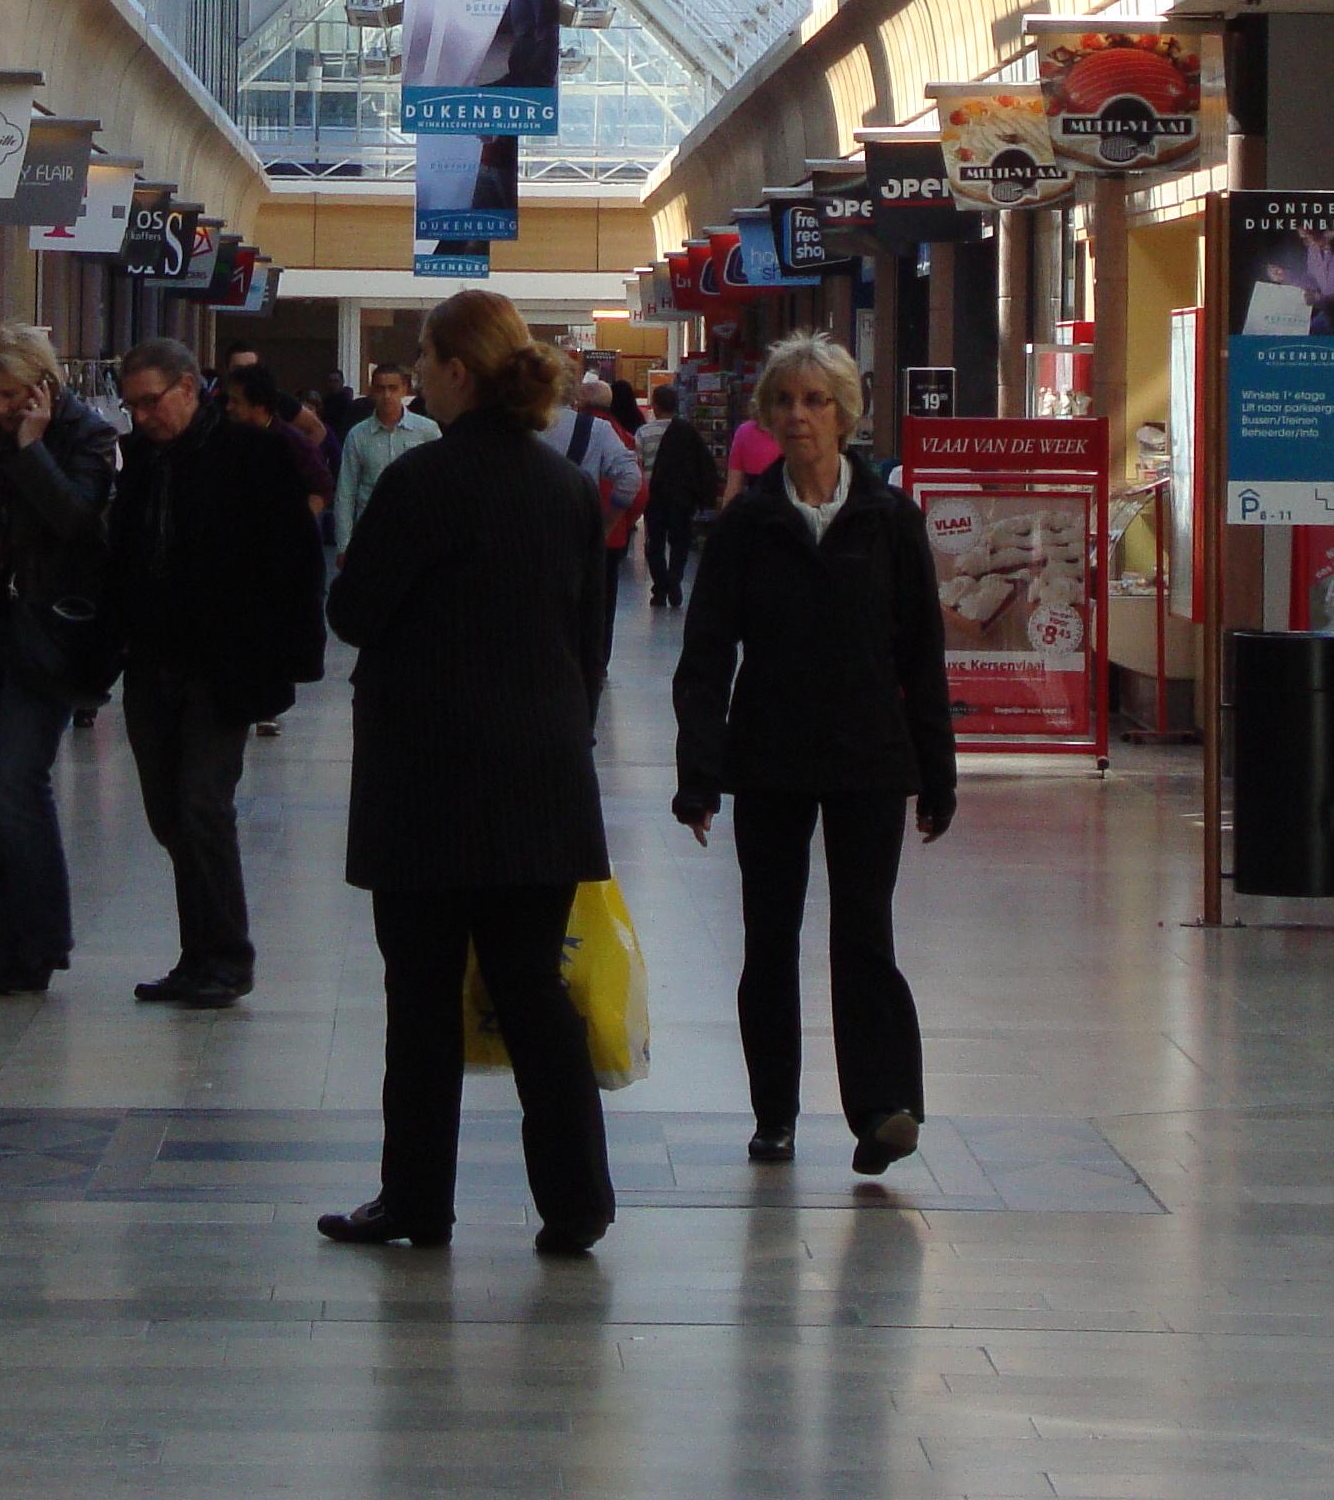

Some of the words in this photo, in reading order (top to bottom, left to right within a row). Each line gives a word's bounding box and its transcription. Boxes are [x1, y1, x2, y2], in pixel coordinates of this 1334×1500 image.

[405, 104, 554, 120] DUKENBURG
[1068, 118, 1186, 135] MULTI-VLAAI
[36, 165, 74, 181] FLAIR
[420, 221, 517, 232] DUKENBURG
[920, 437, 969, 454] VLAAI
[973, 437, 1008, 454] VAN
[1011, 438, 1035, 454] DE
[1039, 438, 1089, 455] WEEK
